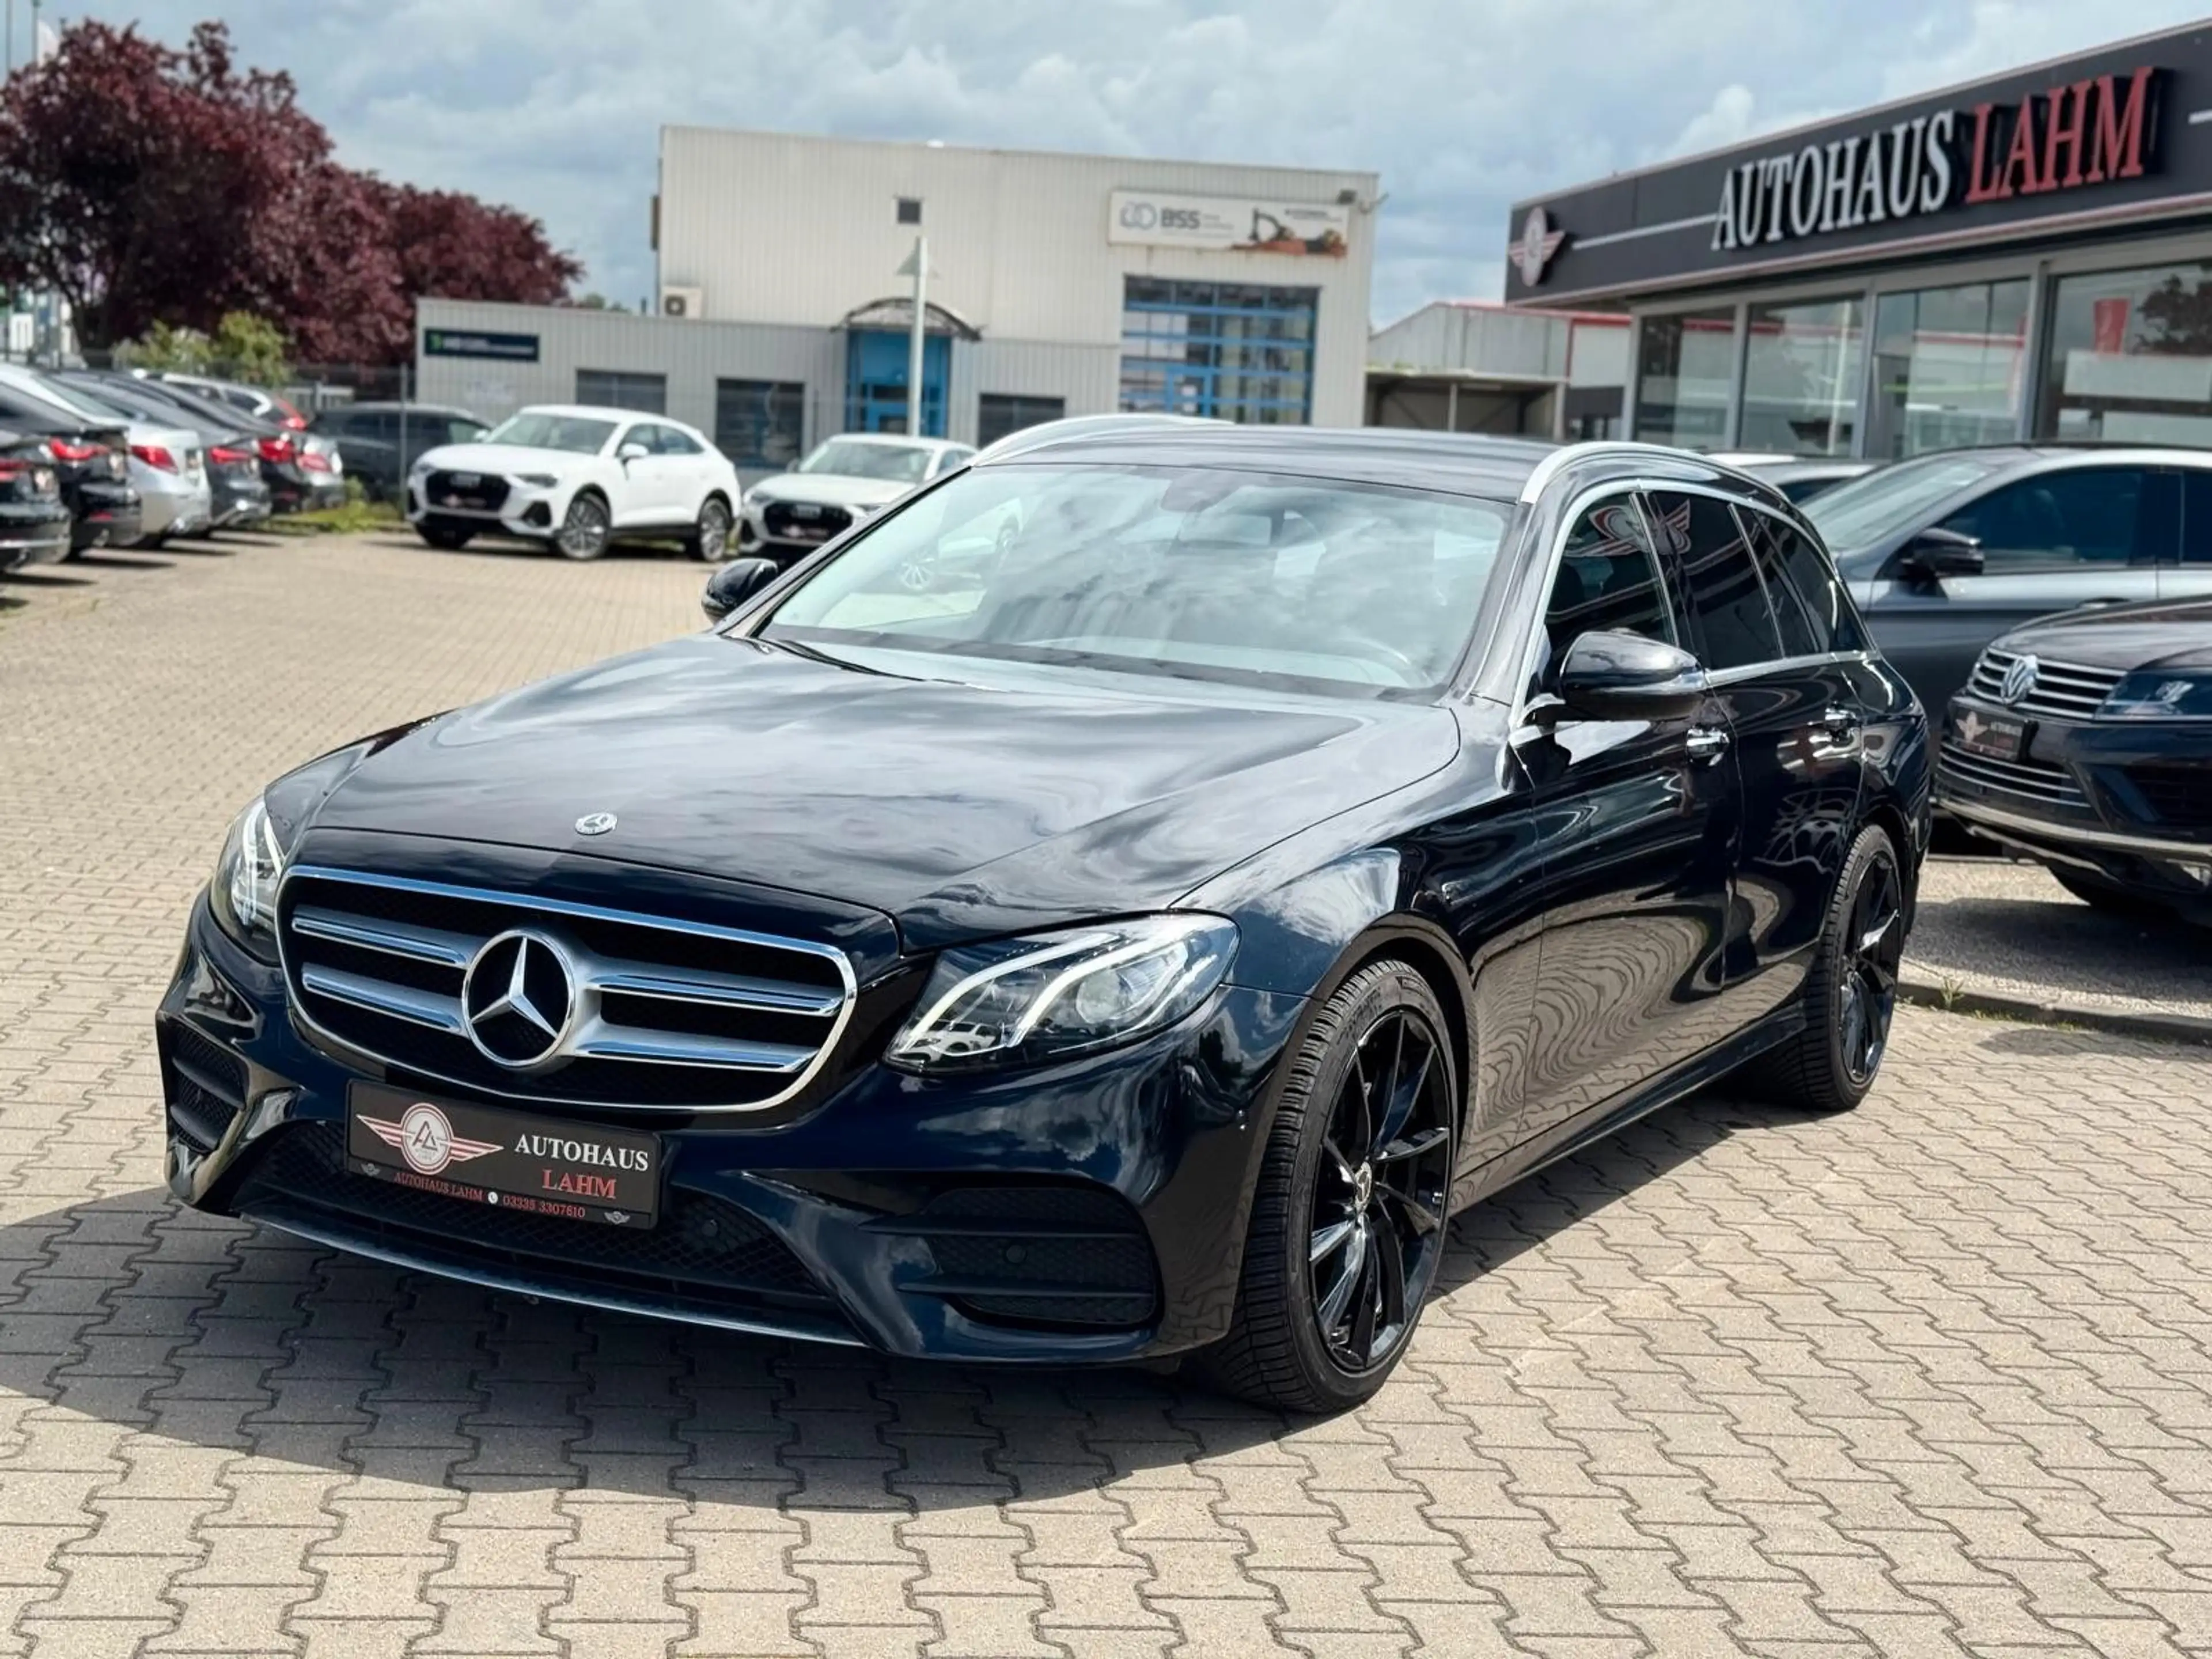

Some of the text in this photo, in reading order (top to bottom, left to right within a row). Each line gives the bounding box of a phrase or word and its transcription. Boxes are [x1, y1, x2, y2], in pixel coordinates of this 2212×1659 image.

[1712, 66, 2153, 249] AUTOHAUS LAHM
[1161, 208, 1200, 230] BSS
[514, 1133, 649, 1172] AUTOHAUS
[393, 1172, 450, 1194] AUTOHAUS
[450, 1184, 484, 1202] LAHM
[542, 1169, 617, 1199] LAHM
